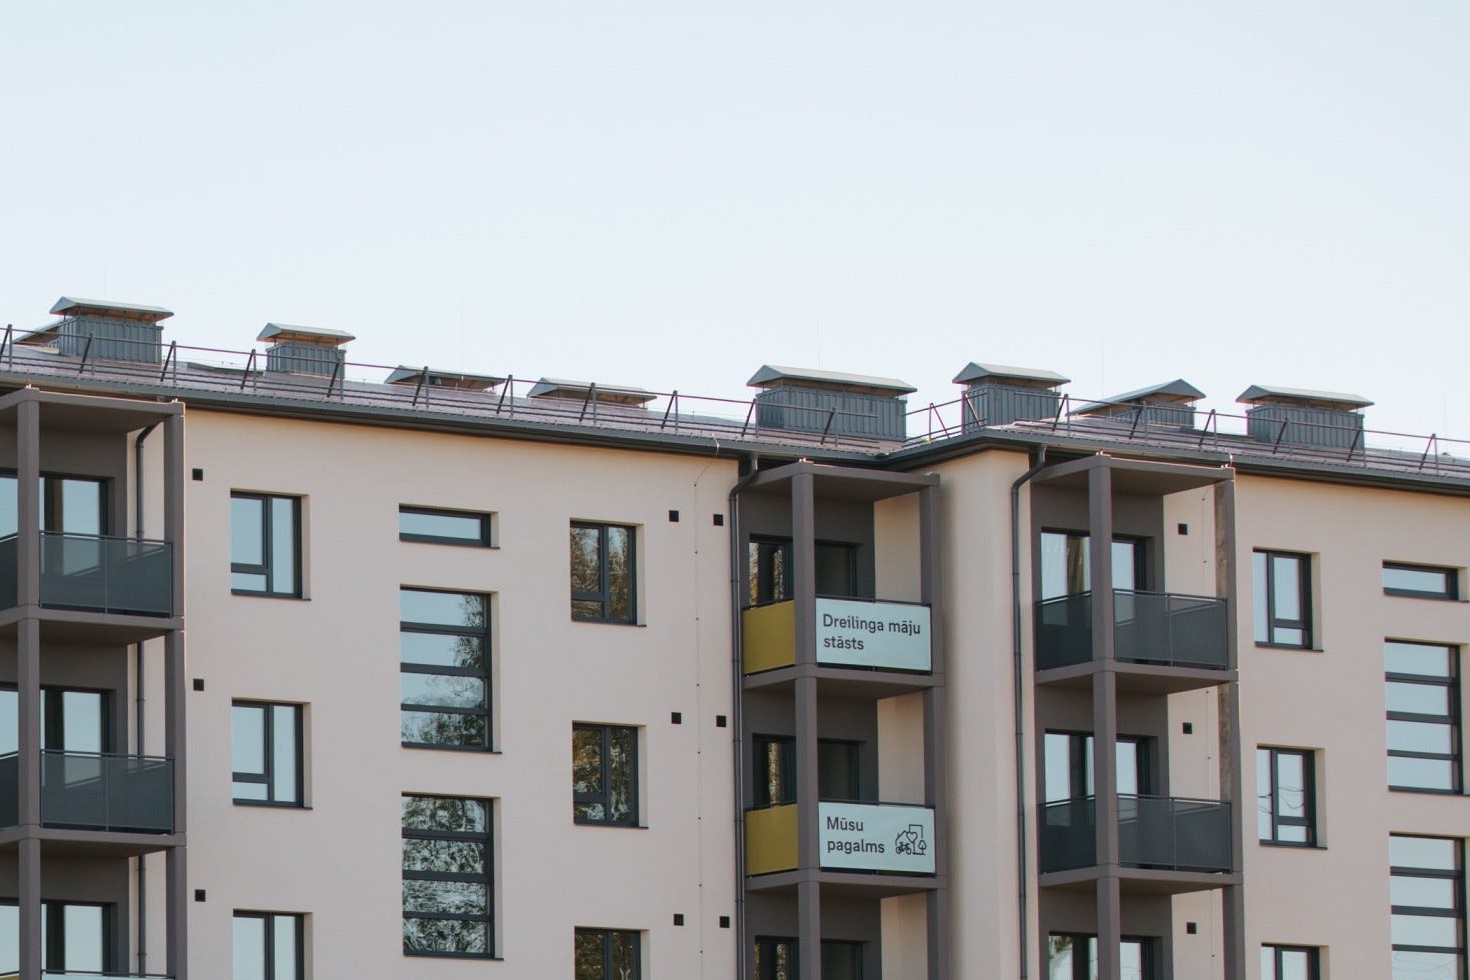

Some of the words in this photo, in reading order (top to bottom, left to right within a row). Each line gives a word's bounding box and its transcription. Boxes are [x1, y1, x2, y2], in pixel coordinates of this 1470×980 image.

[823, 613, 884, 634] Dreilinga
[888, 620, 921, 636] māju
[823, 636, 865, 650] stāsts
[826, 816, 864, 831] Mūsu
[827, 839, 885, 855] pagalms
